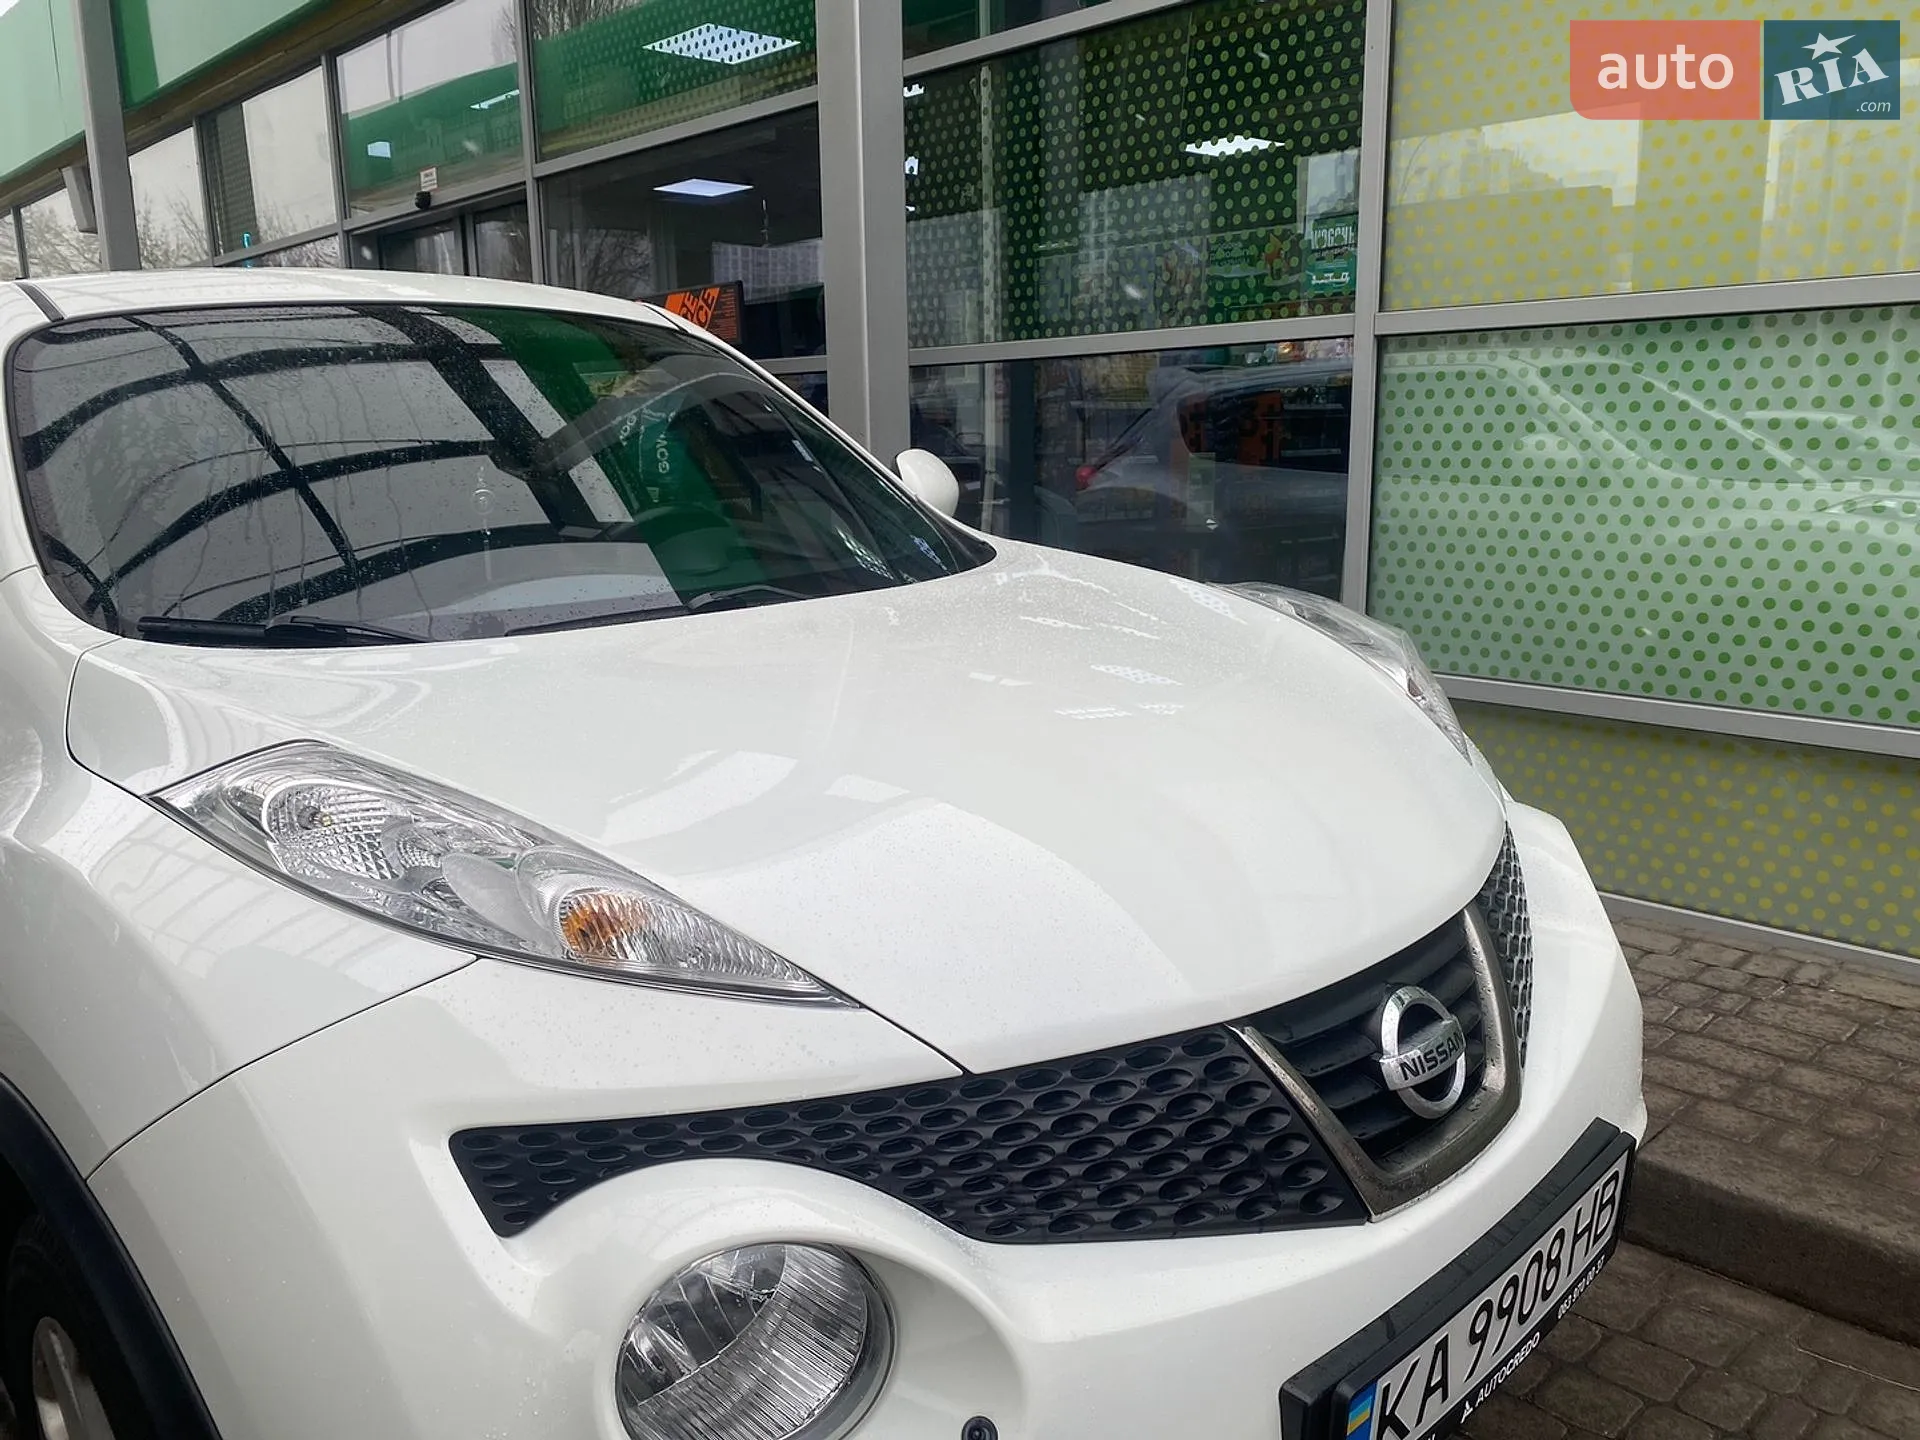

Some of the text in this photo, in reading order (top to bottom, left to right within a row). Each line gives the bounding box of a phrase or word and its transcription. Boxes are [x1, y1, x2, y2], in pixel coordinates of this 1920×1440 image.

[1400, 1031, 1463, 1081] NISSAN
[1374, 1169, 1620, 1440] KA 9908 HB
[1474, 1331, 1540, 1408] AUTOCREDO
